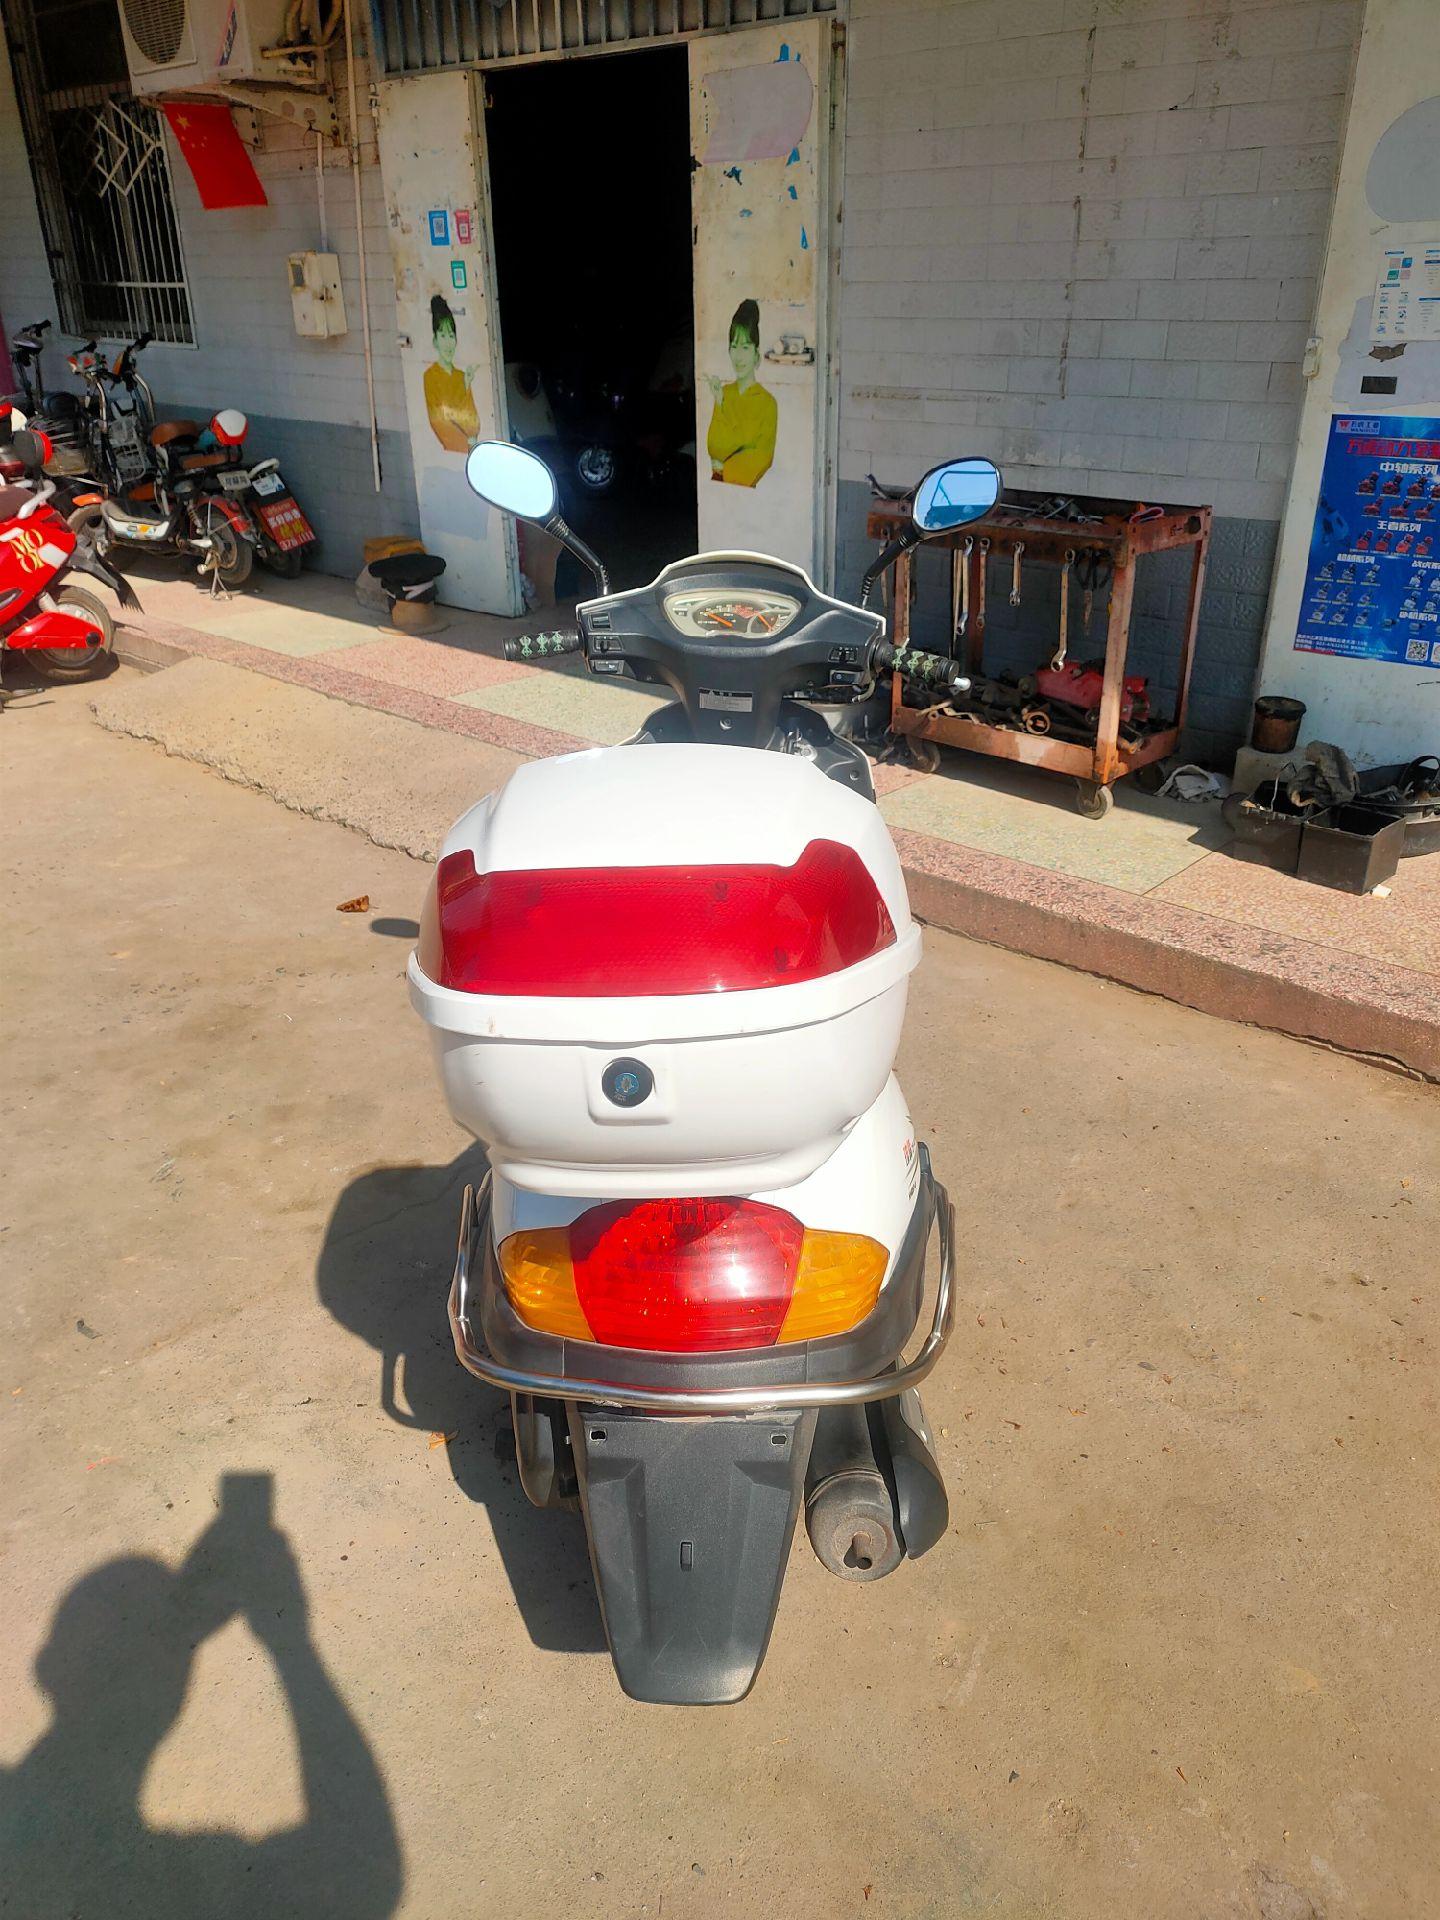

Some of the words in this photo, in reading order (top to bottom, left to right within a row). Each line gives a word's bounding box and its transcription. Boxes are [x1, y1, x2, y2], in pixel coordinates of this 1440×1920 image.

[1380, 461, 1438, 475] 中轴系列
[1377, 520, 1421, 533] 王者系列
